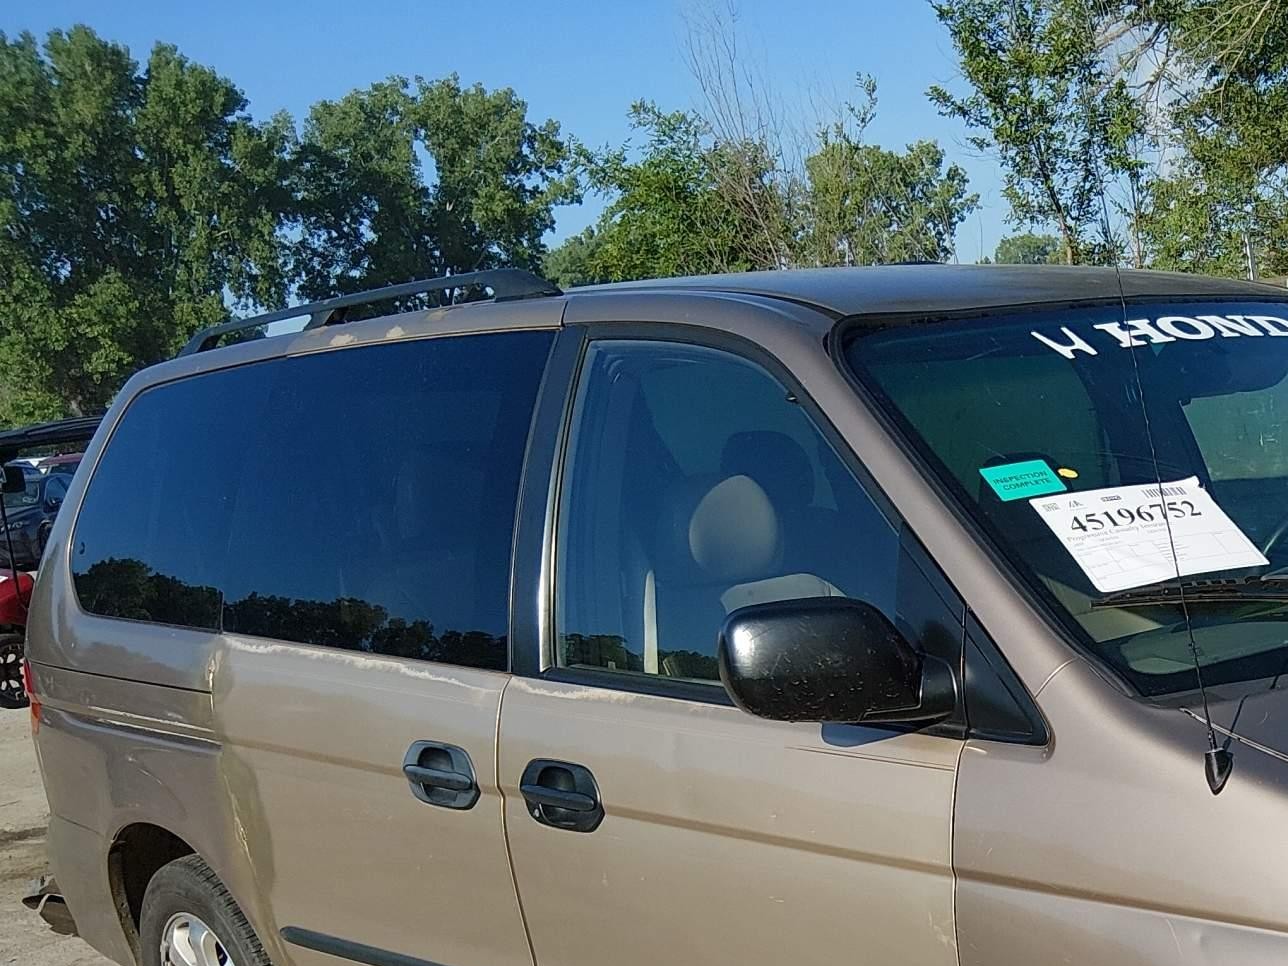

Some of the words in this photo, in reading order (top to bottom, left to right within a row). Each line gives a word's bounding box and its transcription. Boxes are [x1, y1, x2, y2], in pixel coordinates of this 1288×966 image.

[993, 470, 1048, 485] INSPECTION
[1003, 478, 1051, 490] COMPLETE
[1070, 500, 1202, 532] 45196752
